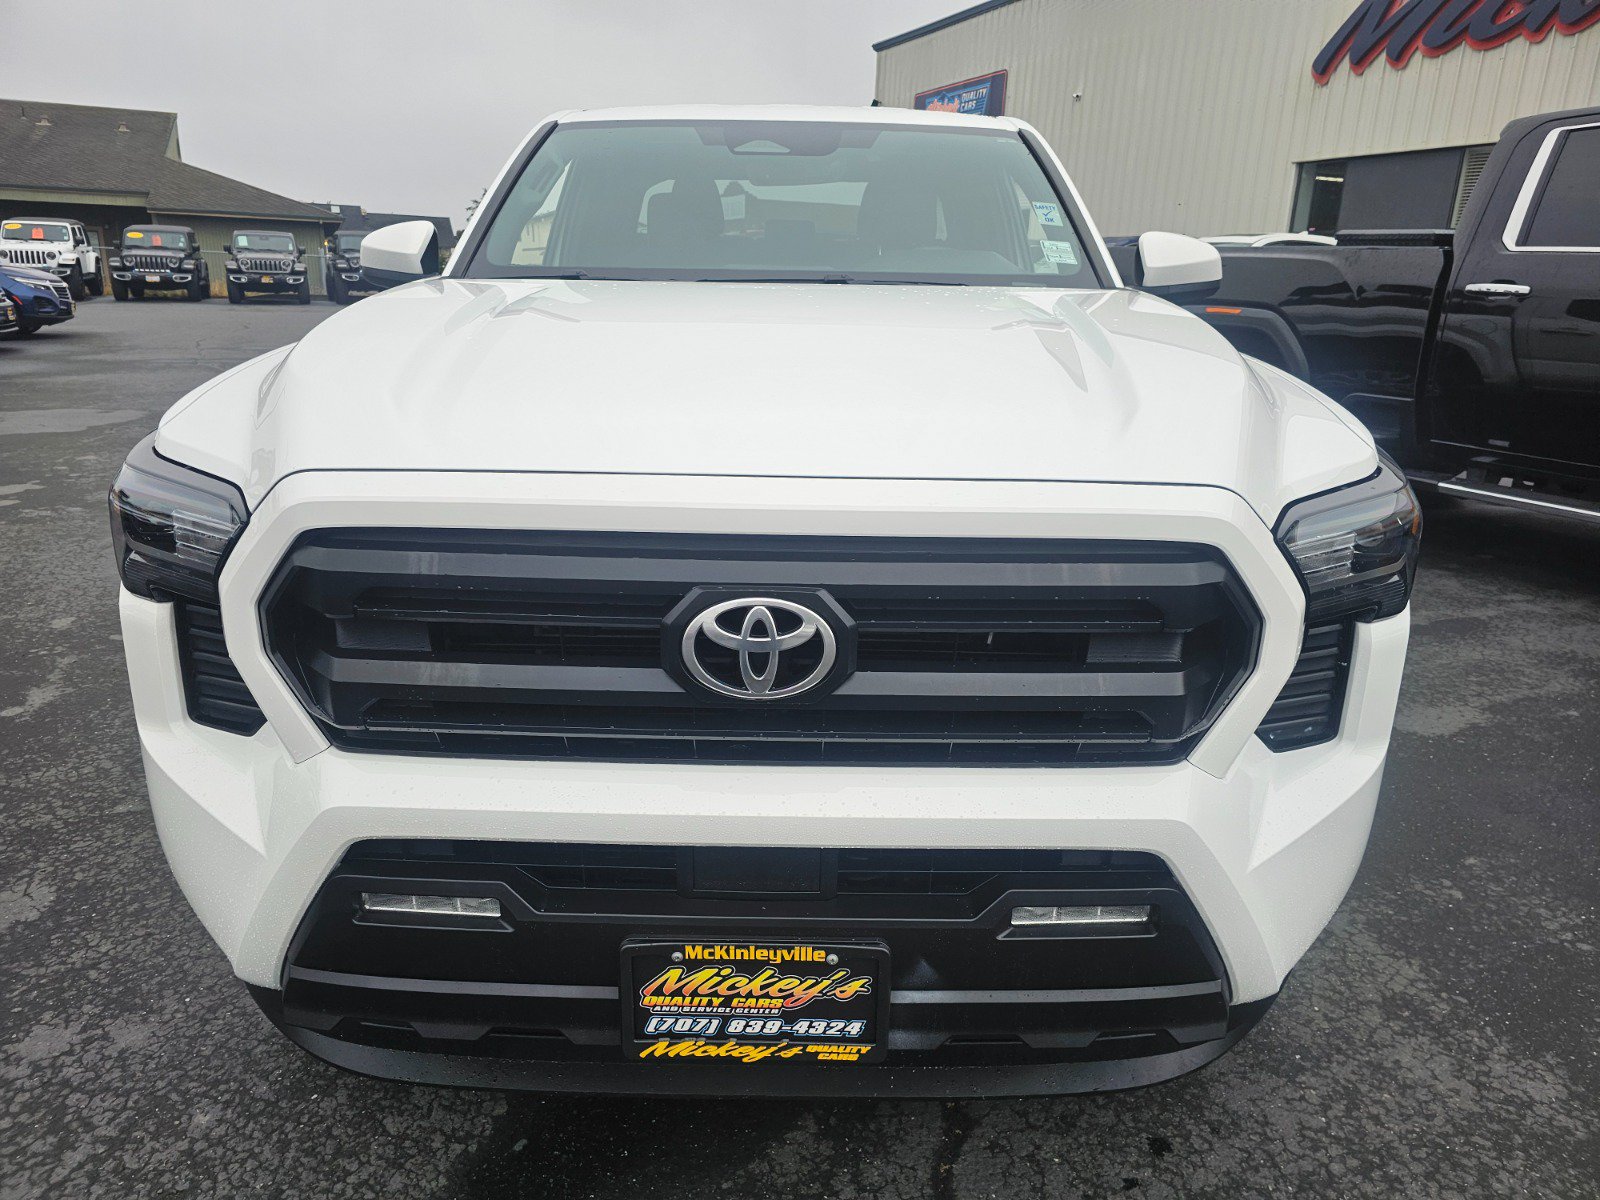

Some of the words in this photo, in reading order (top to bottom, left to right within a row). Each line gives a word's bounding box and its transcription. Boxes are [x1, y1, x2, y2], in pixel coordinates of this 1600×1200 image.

[961, 88, 987, 102] QUALITY
[960, 101, 977, 112] CARS
[684, 945, 826, 964] McKinleyville
[642, 966, 872, 1009] Mickey's
[642, 996, 721, 1007] QUALITY
[730, 997, 784, 1008] CARS
[726, 1019, 864, 1036] 839-4324
[640, 1040, 803, 1062] Mickey's
[806, 1044, 872, 1054] QUALITY
[816, 1053, 859, 1061] CARS
